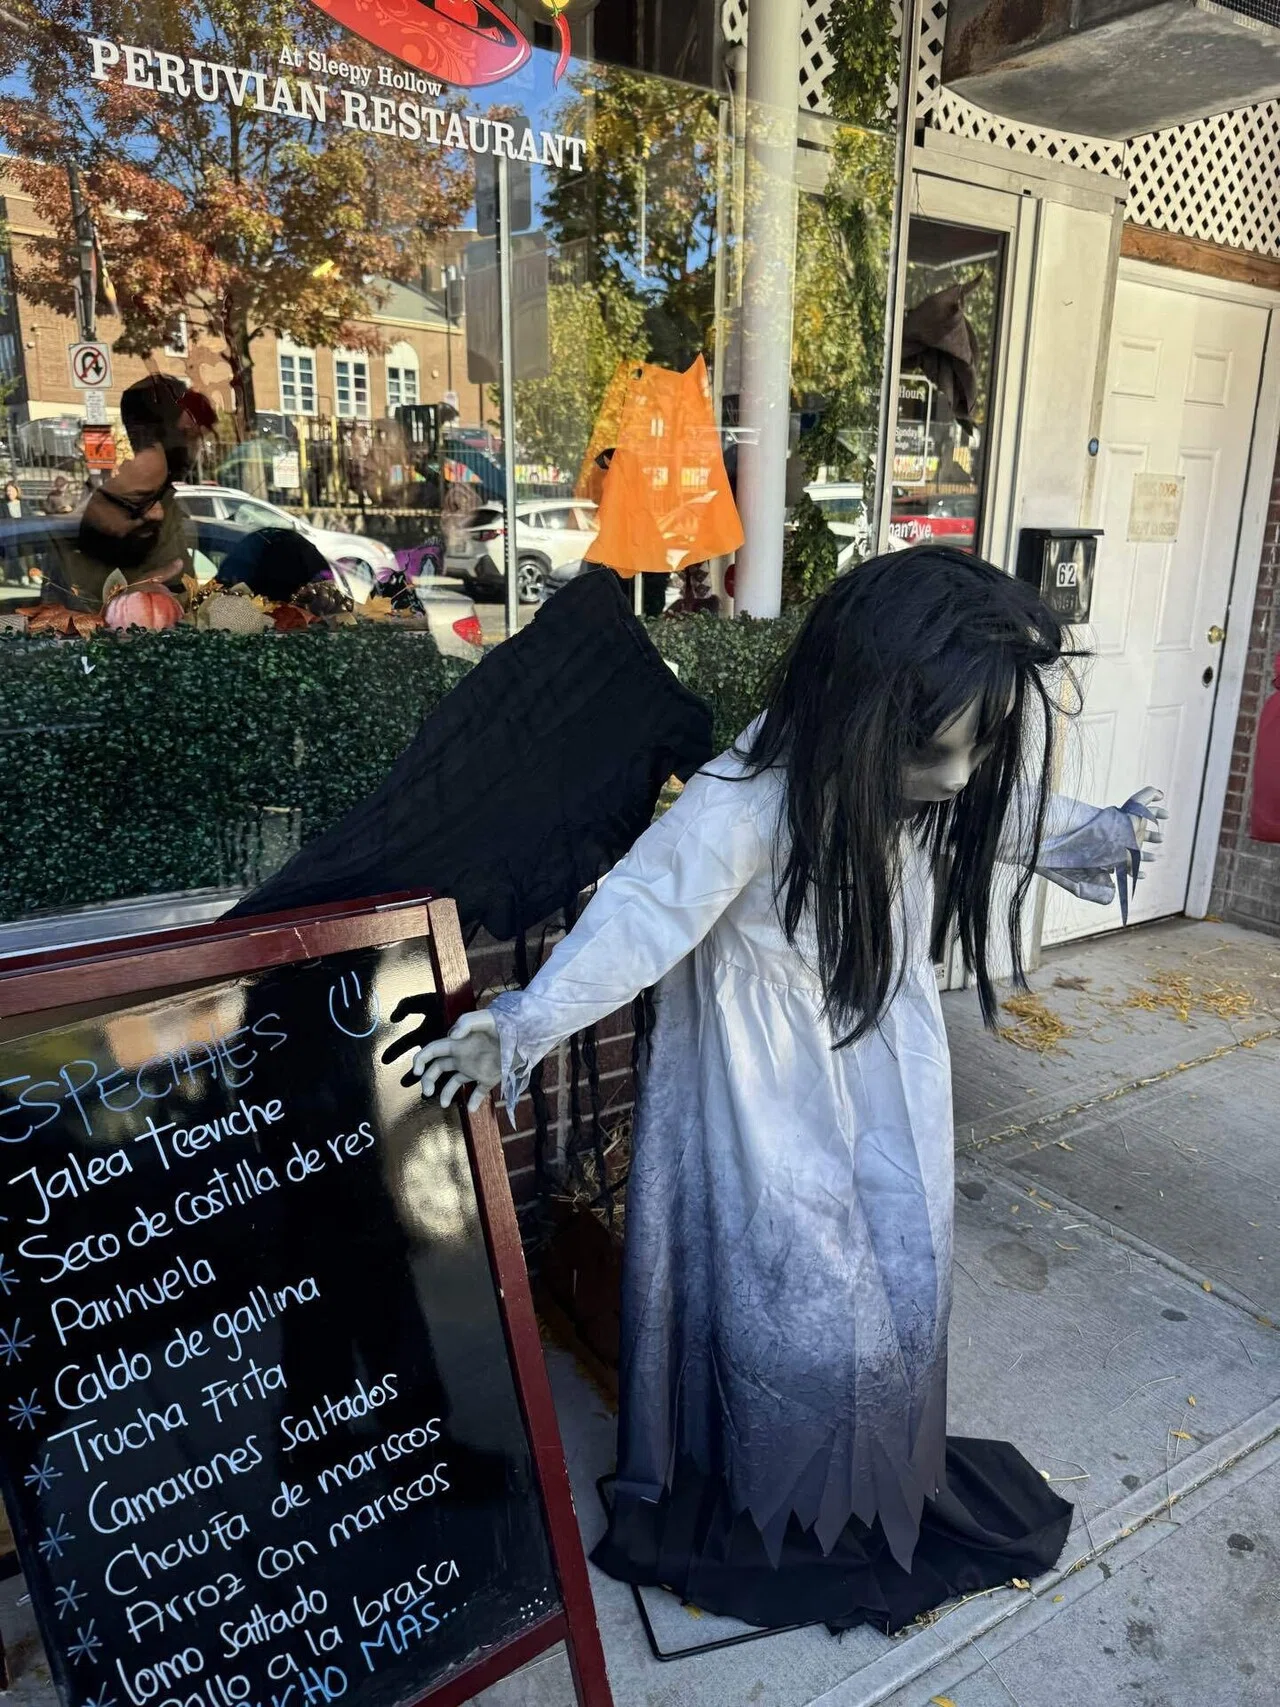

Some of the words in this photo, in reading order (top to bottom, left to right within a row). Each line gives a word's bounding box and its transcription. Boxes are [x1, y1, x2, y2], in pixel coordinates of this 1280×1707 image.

[87, 37, 328, 123] PERUVIAN
[340, 90, 587, 172] RESTAURANT
[278, 46, 302, 68] At
[308, 51, 372, 87] Sleepy
[377, 66, 443, 97] Hollow
[1059, 565, 1076, 585] 62
[8, 1149, 133, 1225] Jalea
[18, 1233, 120, 1283] Seco
[127, 1206, 173, 1247] de
[286, 1141, 326, 1182] de
[327, 1122, 375, 1163] res
[54, 1348, 152, 1410] Caldo
[165, 1327, 210, 1368] de
[213, 1277, 321, 1361] gallina
[48, 1403, 189, 1472] Trucha
[202, 1359, 288, 1423] Frita
[271, 1481, 311, 1518] de
[317, 1418, 441, 1494] mariscos
[89, 1435, 262, 1534] Camarones
[125, 1572, 246, 1643] Arroz
[329, 1462, 450, 1547] mariscos
[268, 1652, 299, 1680] a
[305, 1625, 343, 1657] la
[353, 1560, 460, 1627] brasa
